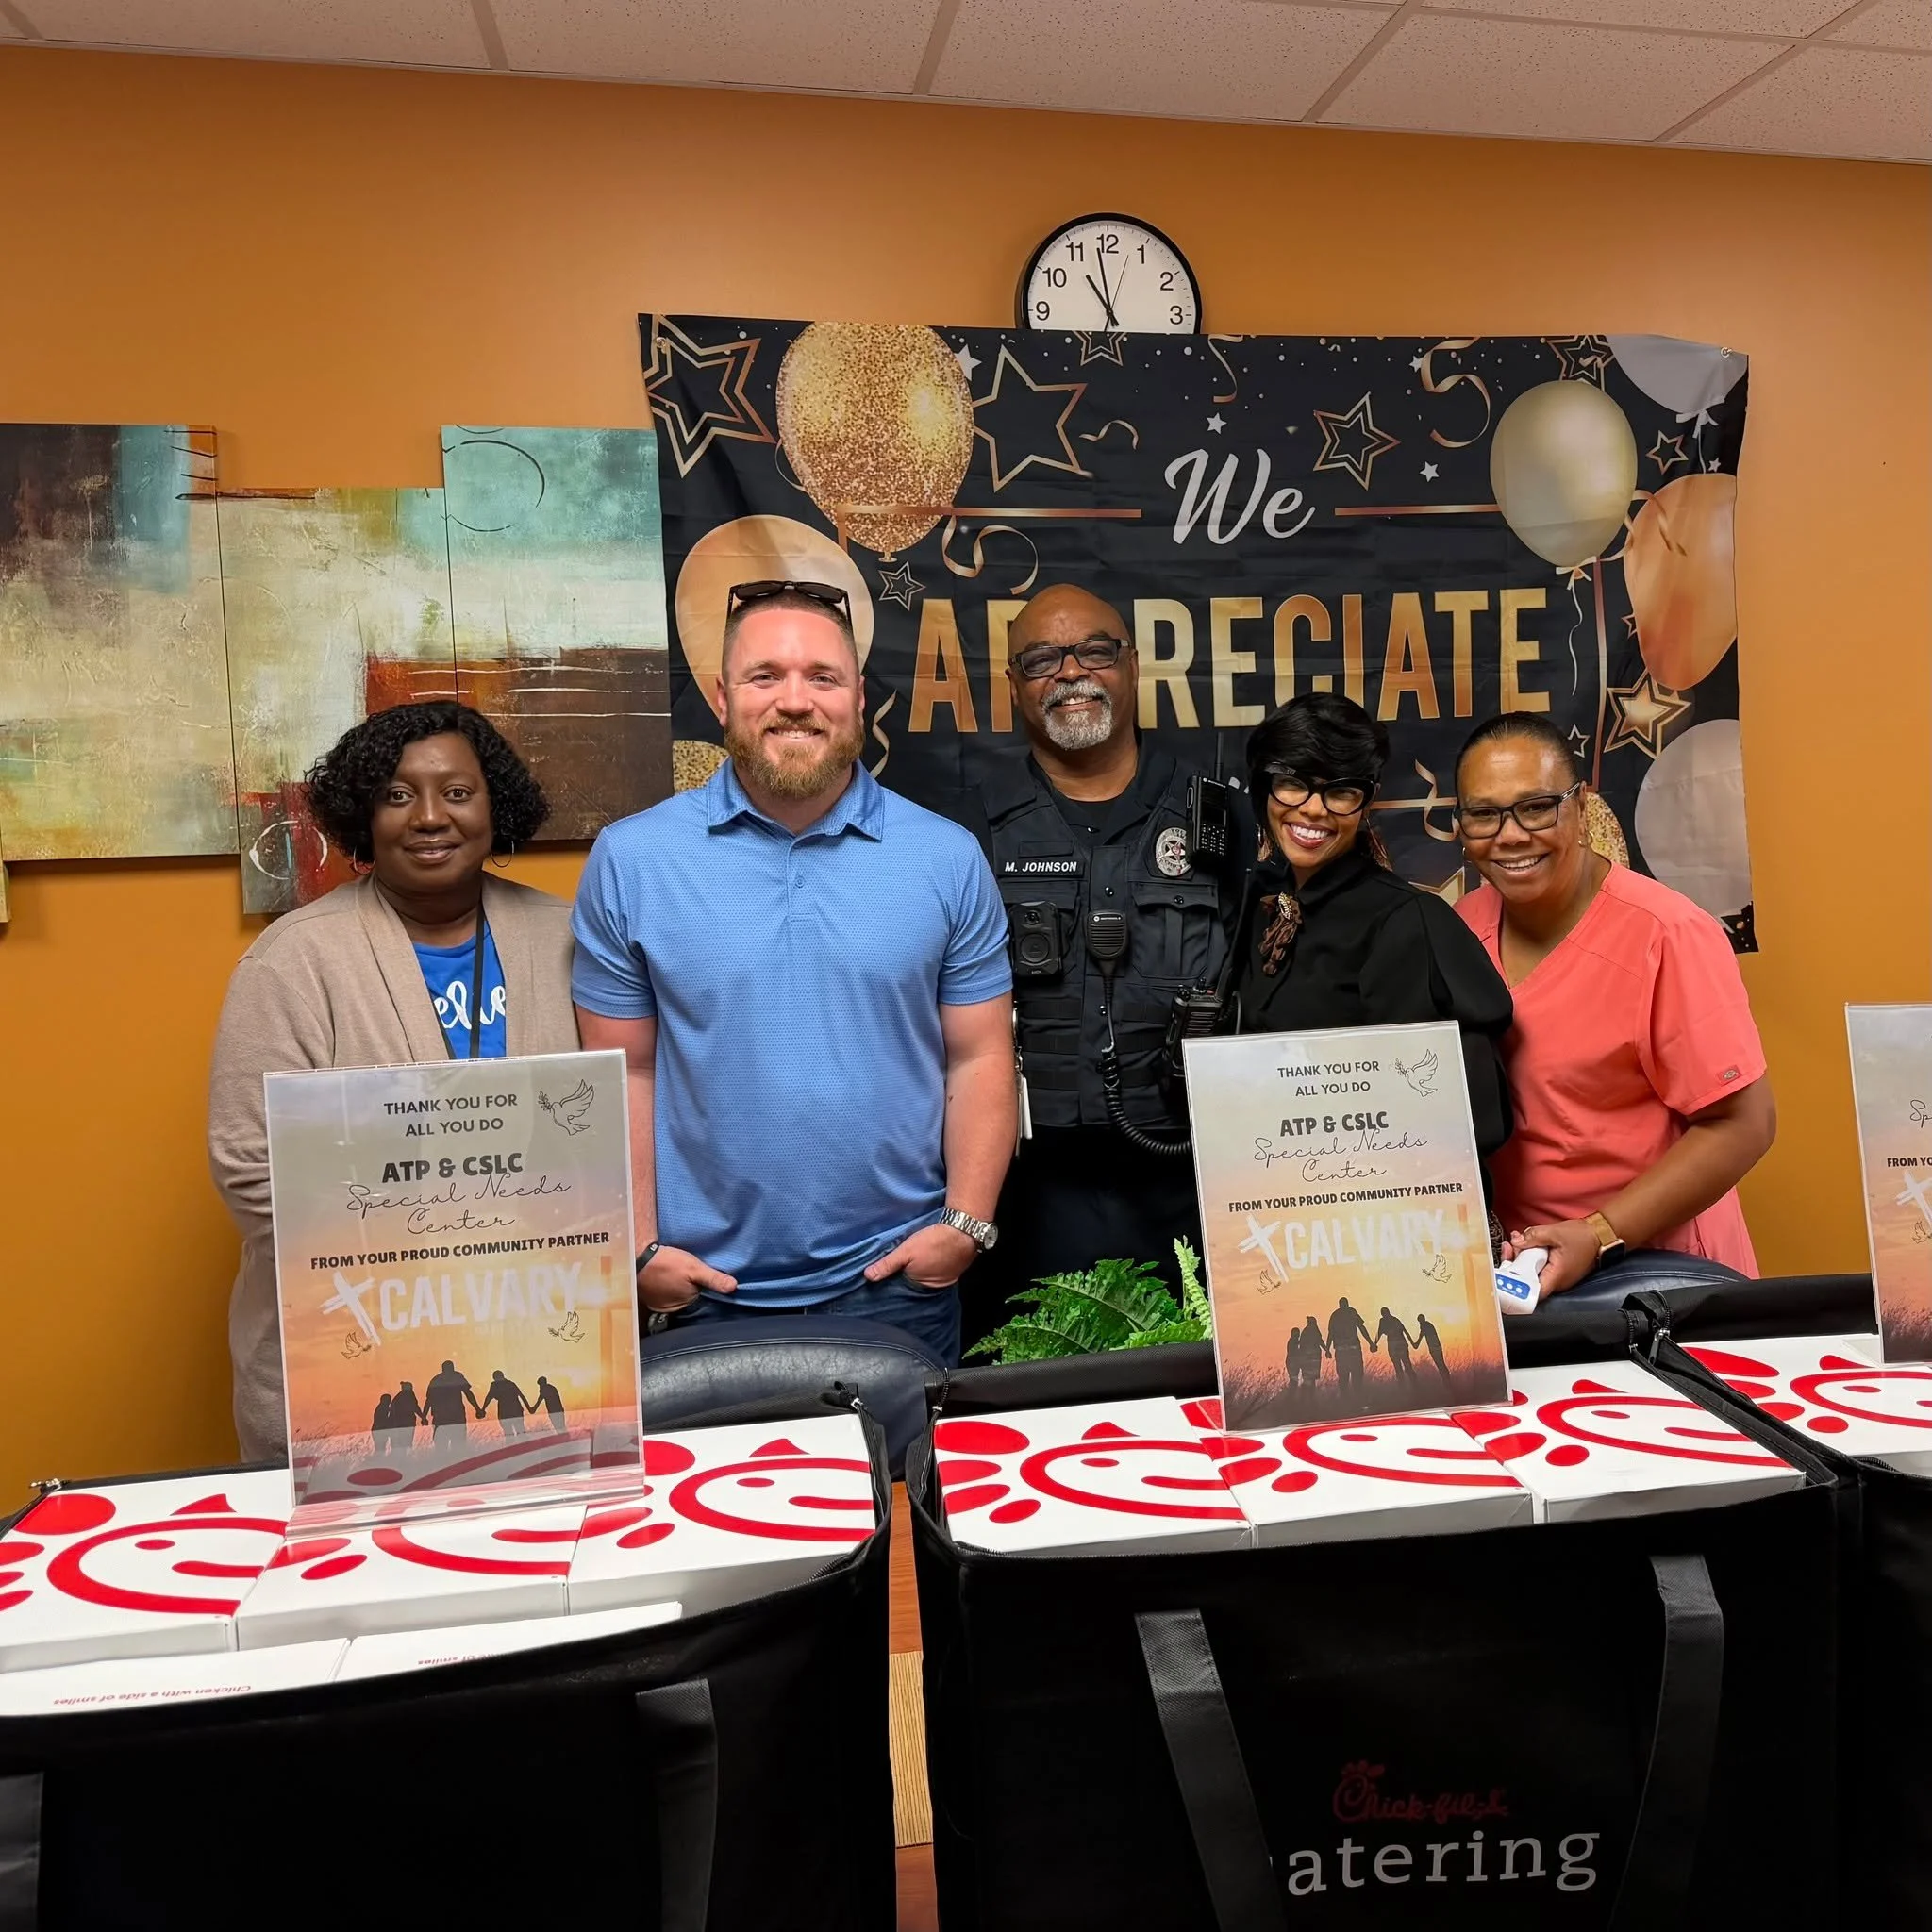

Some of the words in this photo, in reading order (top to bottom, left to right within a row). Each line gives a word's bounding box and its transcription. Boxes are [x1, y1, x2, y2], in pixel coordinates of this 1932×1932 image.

[1065, 242, 1084, 261] 11
[1096, 234, 1119, 254] 12
[1136, 244, 1145, 264] 1
[1042, 267, 1067, 288] 10
[1160, 272, 1174, 291] 2
[1036, 301, 1050, 321] 9
[1170, 306, 1183, 325] 3
[1164, 448, 1316, 544] We
[908, 588, 1550, 733] APRECIATE
[1005, 861, 1018, 872] M.
[1022, 861, 1077, 872] JOHNSON
[1277, 1064, 1321, 1078] THANK
[1324, 1062, 1352, 1075] YOU
[1356, 1060, 1380, 1073] FOR
[1295, 1084, 1318, 1097] ALL
[1321, 1082, 1349, 1094] YOU
[1352, 1081, 1371, 1092] DO
[384, 1098, 441, 1115] THANK
[446, 1095, 482, 1111] YOU
[485, 1093, 518, 1108] FOR
[405, 1122, 435, 1137] ALL
[440, 1119, 475, 1135] YOU
[479, 1118, 504, 1132] DO
[1280, 1117, 1317, 1137] ATP
[1323, 1115, 1337, 1133] &
[1342, 1111, 1389, 1132] CSLC
[1254, 1137, 1348, 1168] Special
[1353, 1127, 1428, 1153] Needs
[382, 1159, 431, 1183] ATP
[438, 1158, 456, 1178] &
[462, 1152, 523, 1176] CSLC
[1301, 1158, 1388, 1183] Center
[1887, 1157, 1918, 1168] FROM
[347, 1182, 467, 1219] Special
[474, 1172, 572, 1200] Needs
[1228, 1200, 1262, 1213] FROM
[1265, 1197, 1297, 1210] YOUR
[1299, 1193, 1338, 1208] PROUD
[1340, 1186, 1412, 1205] COMMUNITY
[1415, 1182, 1463, 1197] PARTNER
[407, 1208, 516, 1235] Center
[1285, 1209, 1444, 1270] CALVARY
[310, 1254, 354, 1270] FROM
[357, 1249, 398, 1266] YOUR
[400, 1244, 449, 1262] PROUD
[453, 1236, 544, 1258] COMMUNITY
[548, 1230, 610, 1249] PARTNER
[379, 1261, 582, 1332] CALVARY
[98, 1693, 115, 1703] of
[119, 1691, 148, 1701] side
[161, 1688, 191, 1697] with
[196, 1685, 252, 1695] Chicken
[54, 1695, 97, 1706] smiles
[1270, 1830, 1601, 1896] atering
